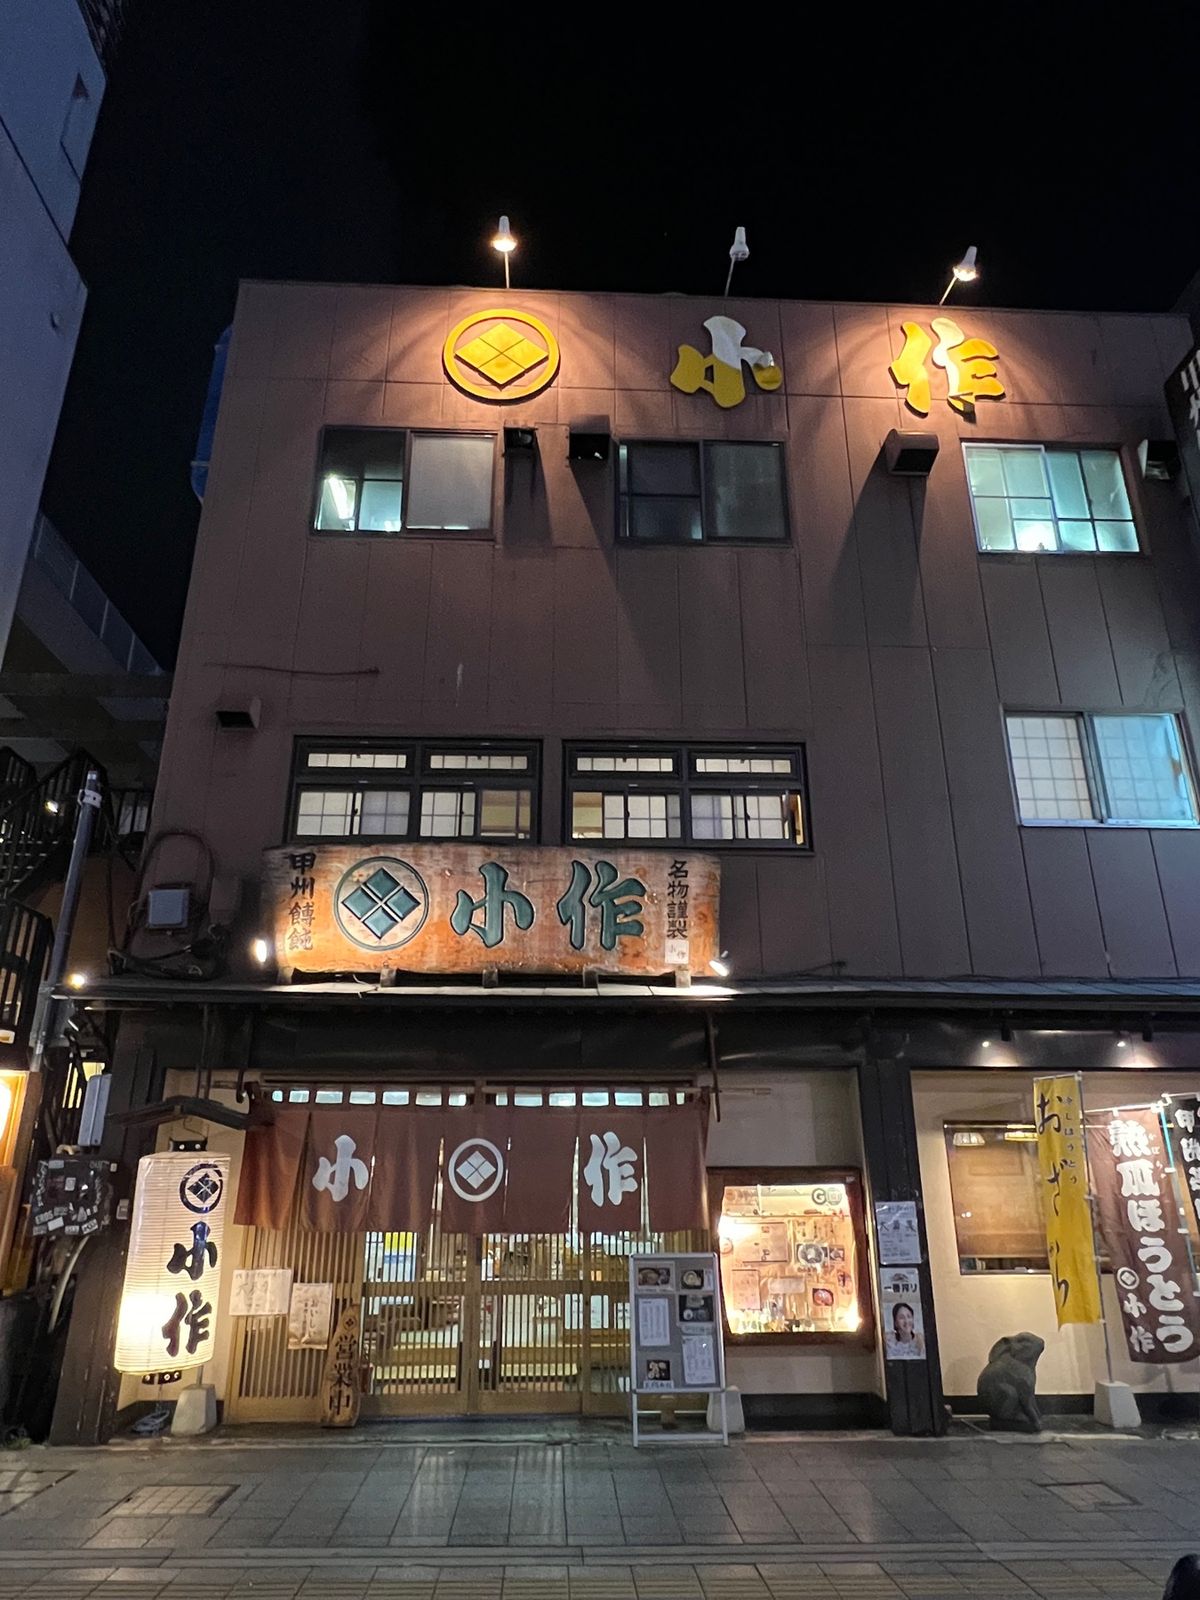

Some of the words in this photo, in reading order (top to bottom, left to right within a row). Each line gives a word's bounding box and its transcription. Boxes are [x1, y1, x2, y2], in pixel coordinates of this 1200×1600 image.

[669, 314, 1006, 422] 小作
[451, 859, 648, 951] 小作
[666, 859, 689, 939] 名物謹製
[312, 1134, 369, 1202] 小
[584, 1131, 638, 1206] 作
[162, 1220, 218, 1358] 小作
[883, 1282, 918, 1294] 一番搾り
[1122, 1292, 1156, 1354] 小作
[328, 1333, 357, 1416] 営業中
